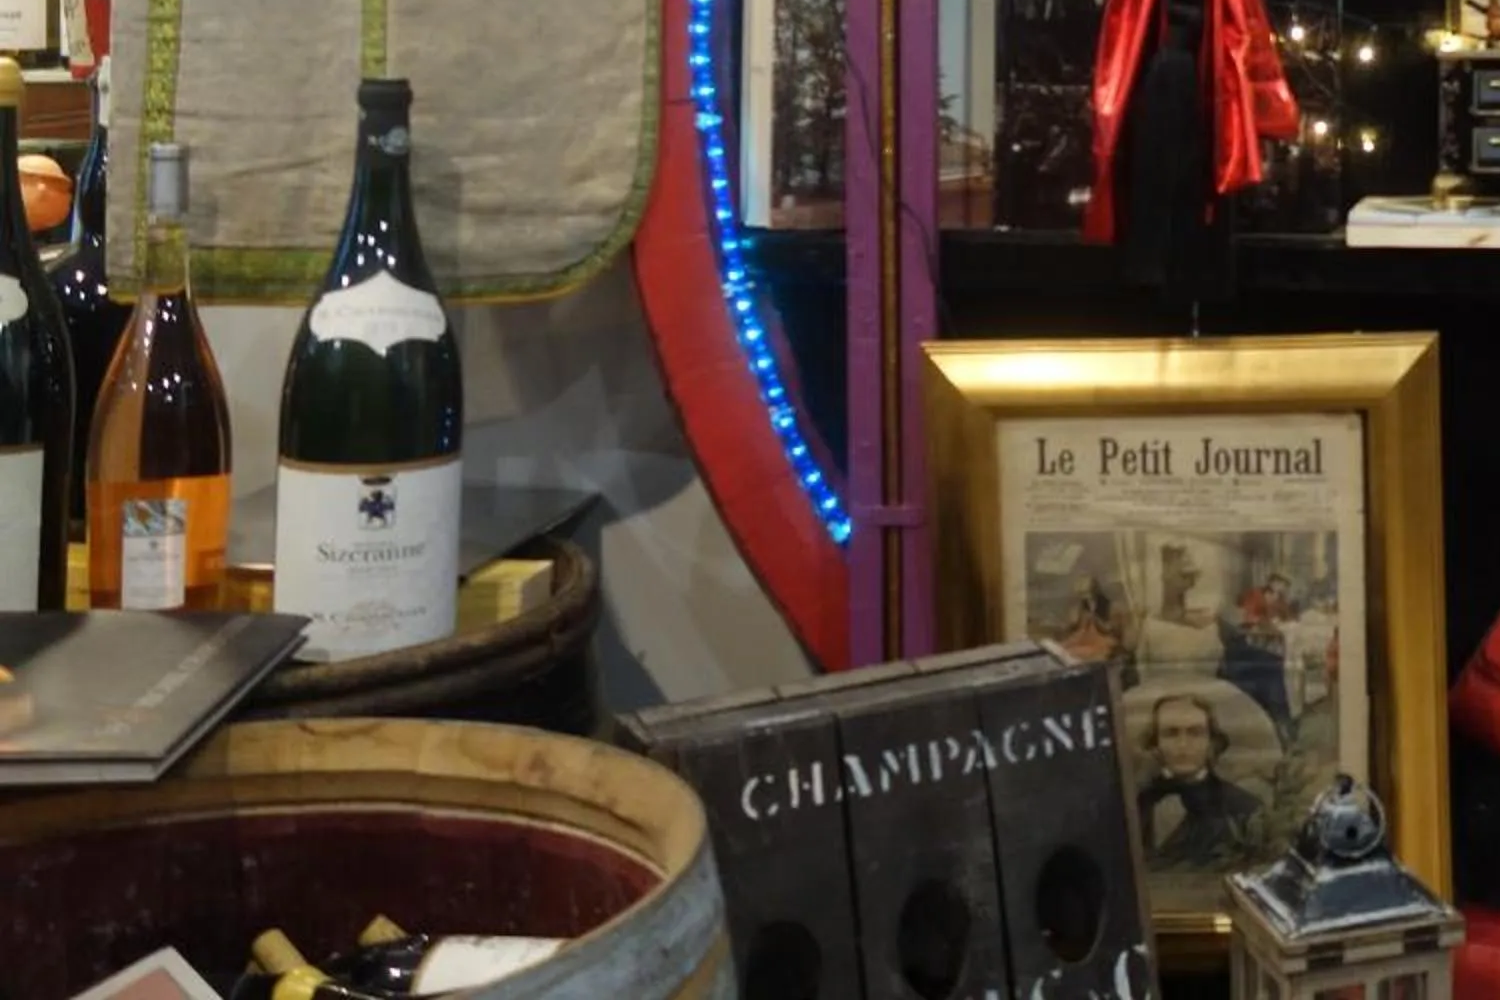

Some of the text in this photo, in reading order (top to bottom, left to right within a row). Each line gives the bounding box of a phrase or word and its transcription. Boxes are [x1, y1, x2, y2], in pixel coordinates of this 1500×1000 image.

[1036, 437, 1324, 476] Le Petit Journal
[741, 704, 1111, 821] CHAMPAGNE
